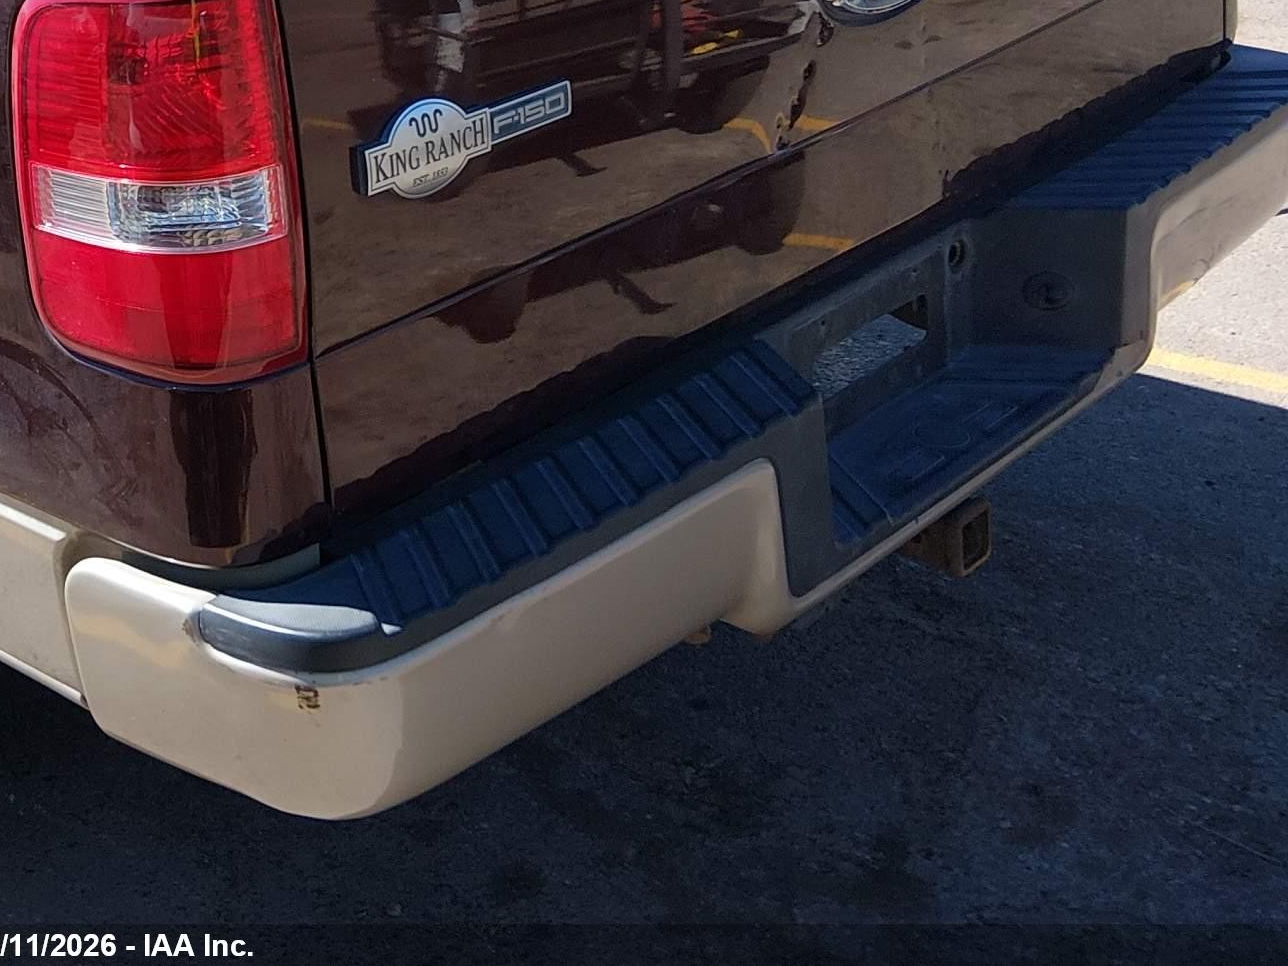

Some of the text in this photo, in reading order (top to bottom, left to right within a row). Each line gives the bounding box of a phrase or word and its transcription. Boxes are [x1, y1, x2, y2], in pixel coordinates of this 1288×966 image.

[494, 93, 565, 134] F-150
[373, 118, 486, 184] KING RANCH
